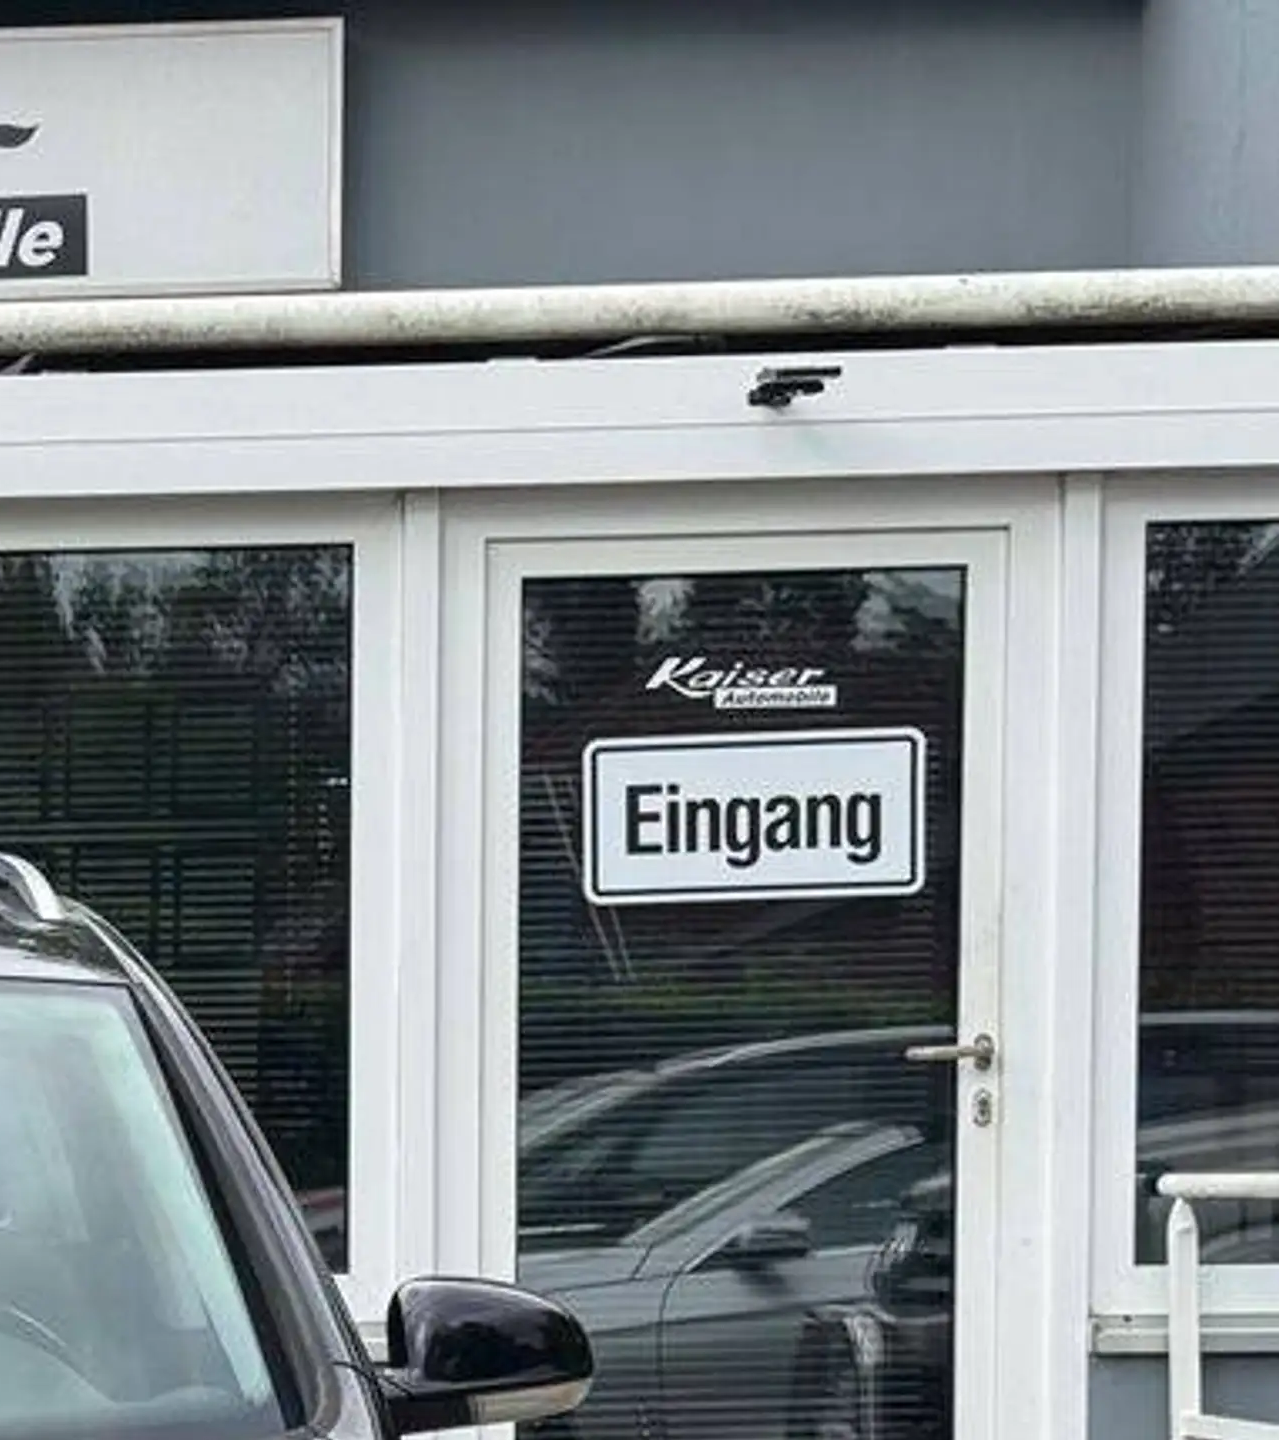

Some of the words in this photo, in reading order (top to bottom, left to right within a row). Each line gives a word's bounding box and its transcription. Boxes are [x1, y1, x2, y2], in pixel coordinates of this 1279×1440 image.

[645, 657, 826, 699] Kaiser
[721, 686, 831, 706] Automobile
[624, 783, 883, 869] Eingang
